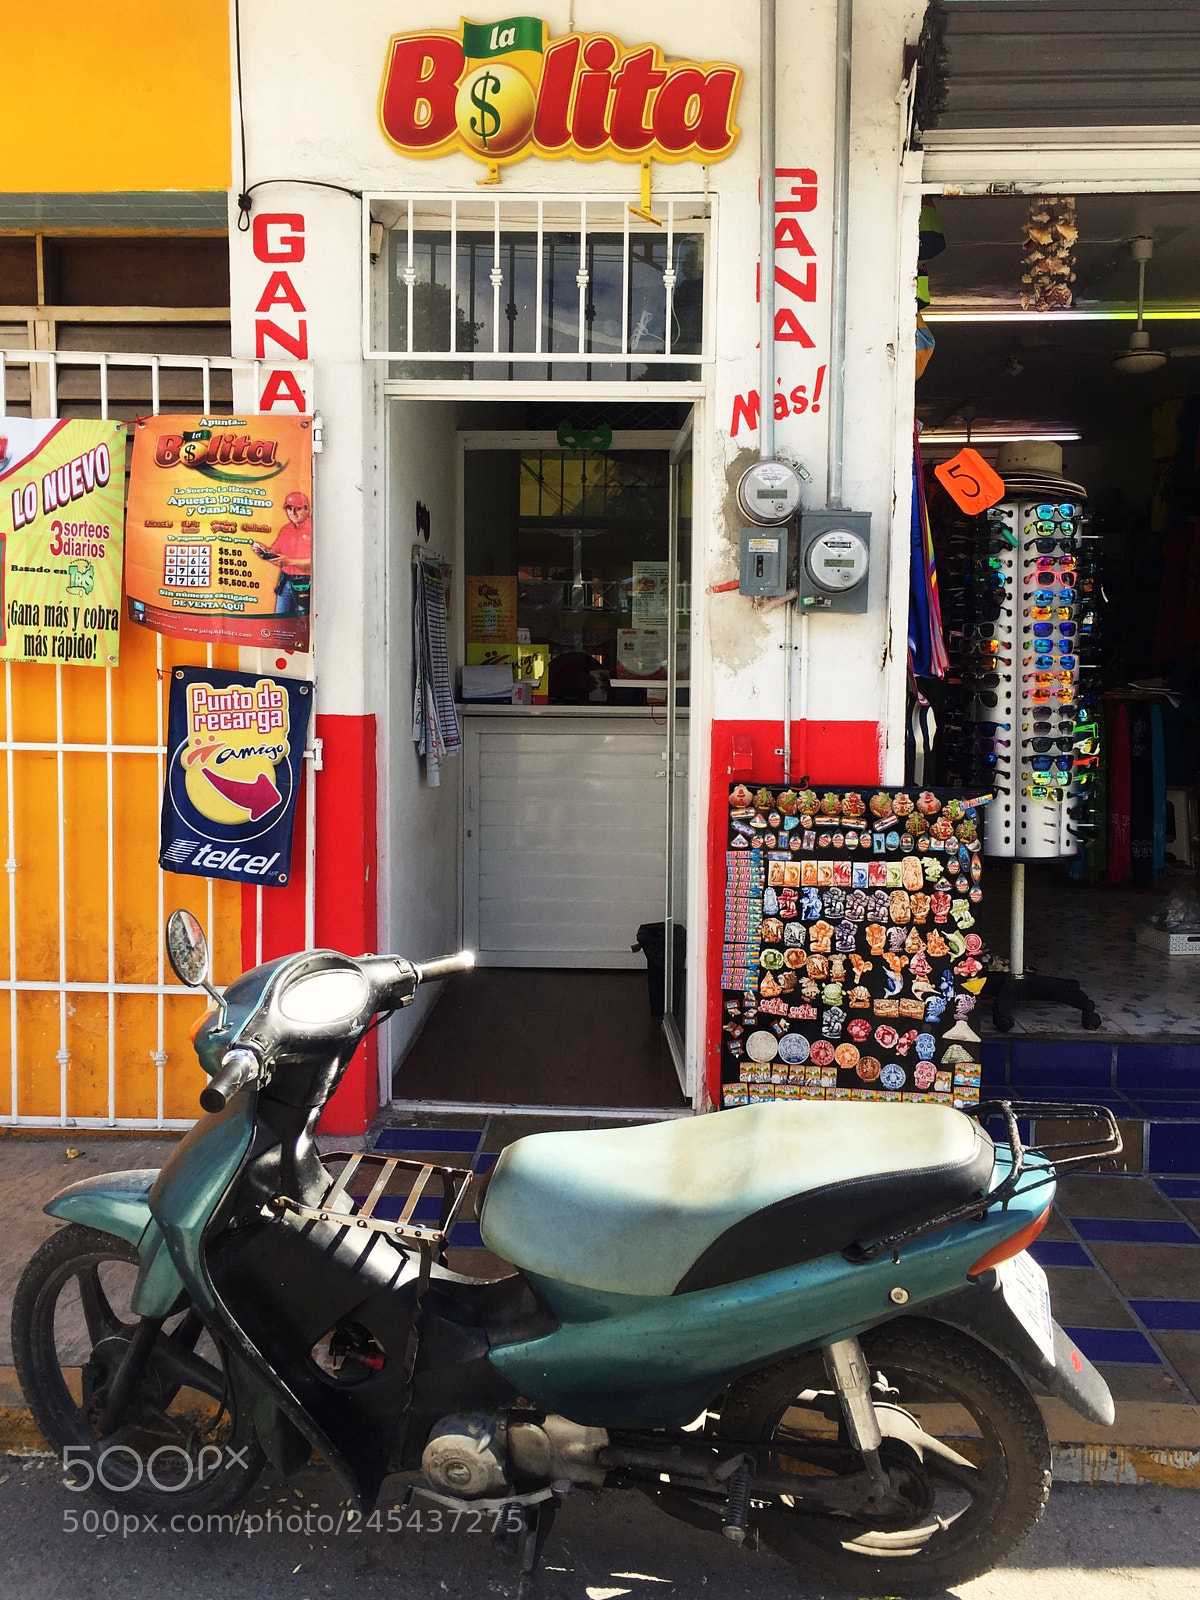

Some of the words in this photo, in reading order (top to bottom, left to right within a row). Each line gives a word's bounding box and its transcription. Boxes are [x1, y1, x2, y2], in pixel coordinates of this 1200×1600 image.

[489, 26, 516, 51] la
[253, 213, 308, 412] GANA
[200, 418, 246, 427] Apunta...
[12, 482, 38, 531] LO
[42, 443, 110, 515] NUEVO
[947, 464, 981, 498] 5
[168, 496, 216, 507] Apuesta
[219, 495, 230, 504] lo
[233, 497, 272, 507] mismo
[187, 507, 194, 516] y
[197, 505, 226, 514] Gana
[229, 504, 252, 516] Más
[50, 520, 63, 555] 3
[64, 520, 110, 539] sorteos
[64, 538, 105, 559] diarios
[218, 547, 242, 556] $5.50
[11, 565, 50, 574] Basado
[218, 557, 247, 567] $55.00
[218, 567, 252, 578] $550.00
[218, 577, 260, 589] $5,500.00
[159, 589, 174, 597] Sin
[176, 590, 213, 599] números
[215, 590, 258, 603] castigados
[173, 599, 187, 607] DE
[188, 600, 220, 608] VENTA
[221, 601, 244, 611] AQUÍ
[8, 600, 39, 629] ¡Gana
[44, 601, 68, 627] más
[72, 607, 80, 631] y
[84, 605, 119, 631] cobra
[24, 630, 48, 657] más
[52, 631, 97, 661] rápido!
[192, 687, 252, 712] Punto
[257, 684, 282, 709] de
[194, 710, 283, 734] recarga
[216, 743, 284, 765] amigo
[192, 844, 281, 875] telcel
